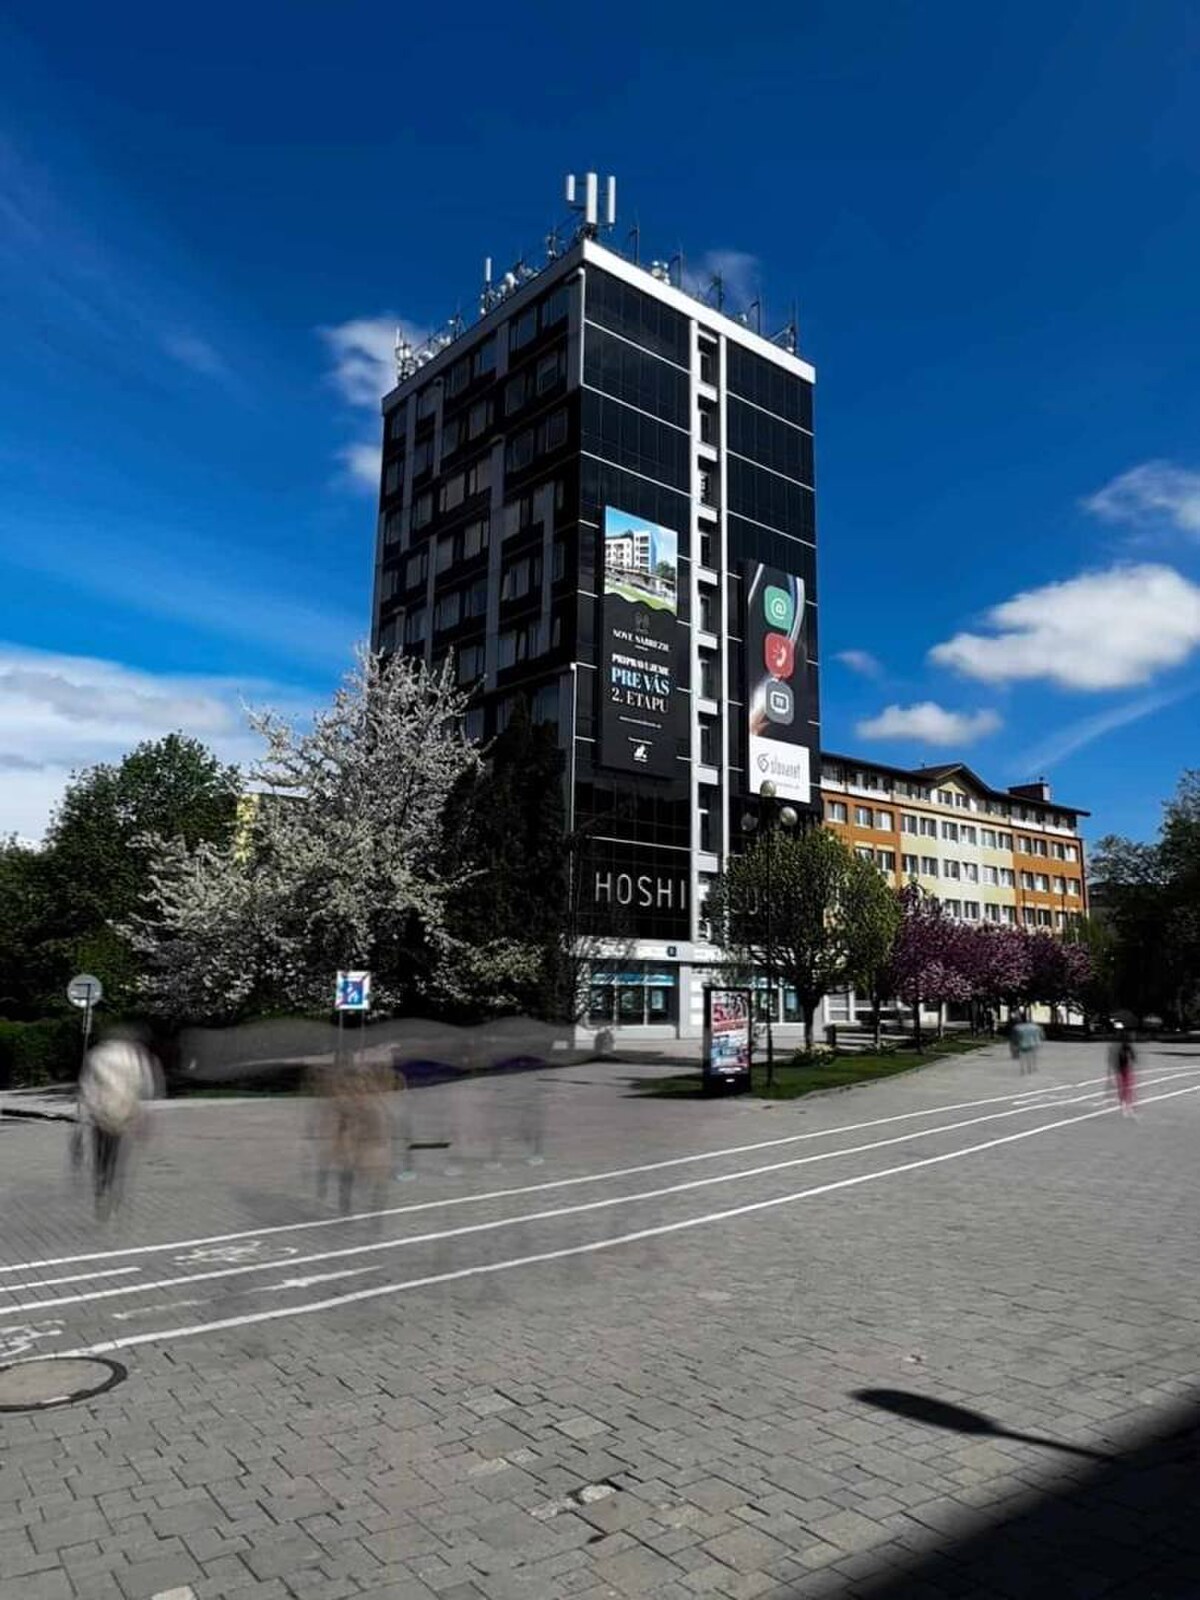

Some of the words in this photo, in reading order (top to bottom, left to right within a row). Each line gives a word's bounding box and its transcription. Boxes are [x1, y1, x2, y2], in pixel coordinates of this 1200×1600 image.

[612, 667, 641, 688] PRE
[643, 674, 670, 696] VÁS
[612, 687, 623, 703] 2.
[627, 690, 668, 714] ETAPU
[595, 871, 686, 910] HOSHI
